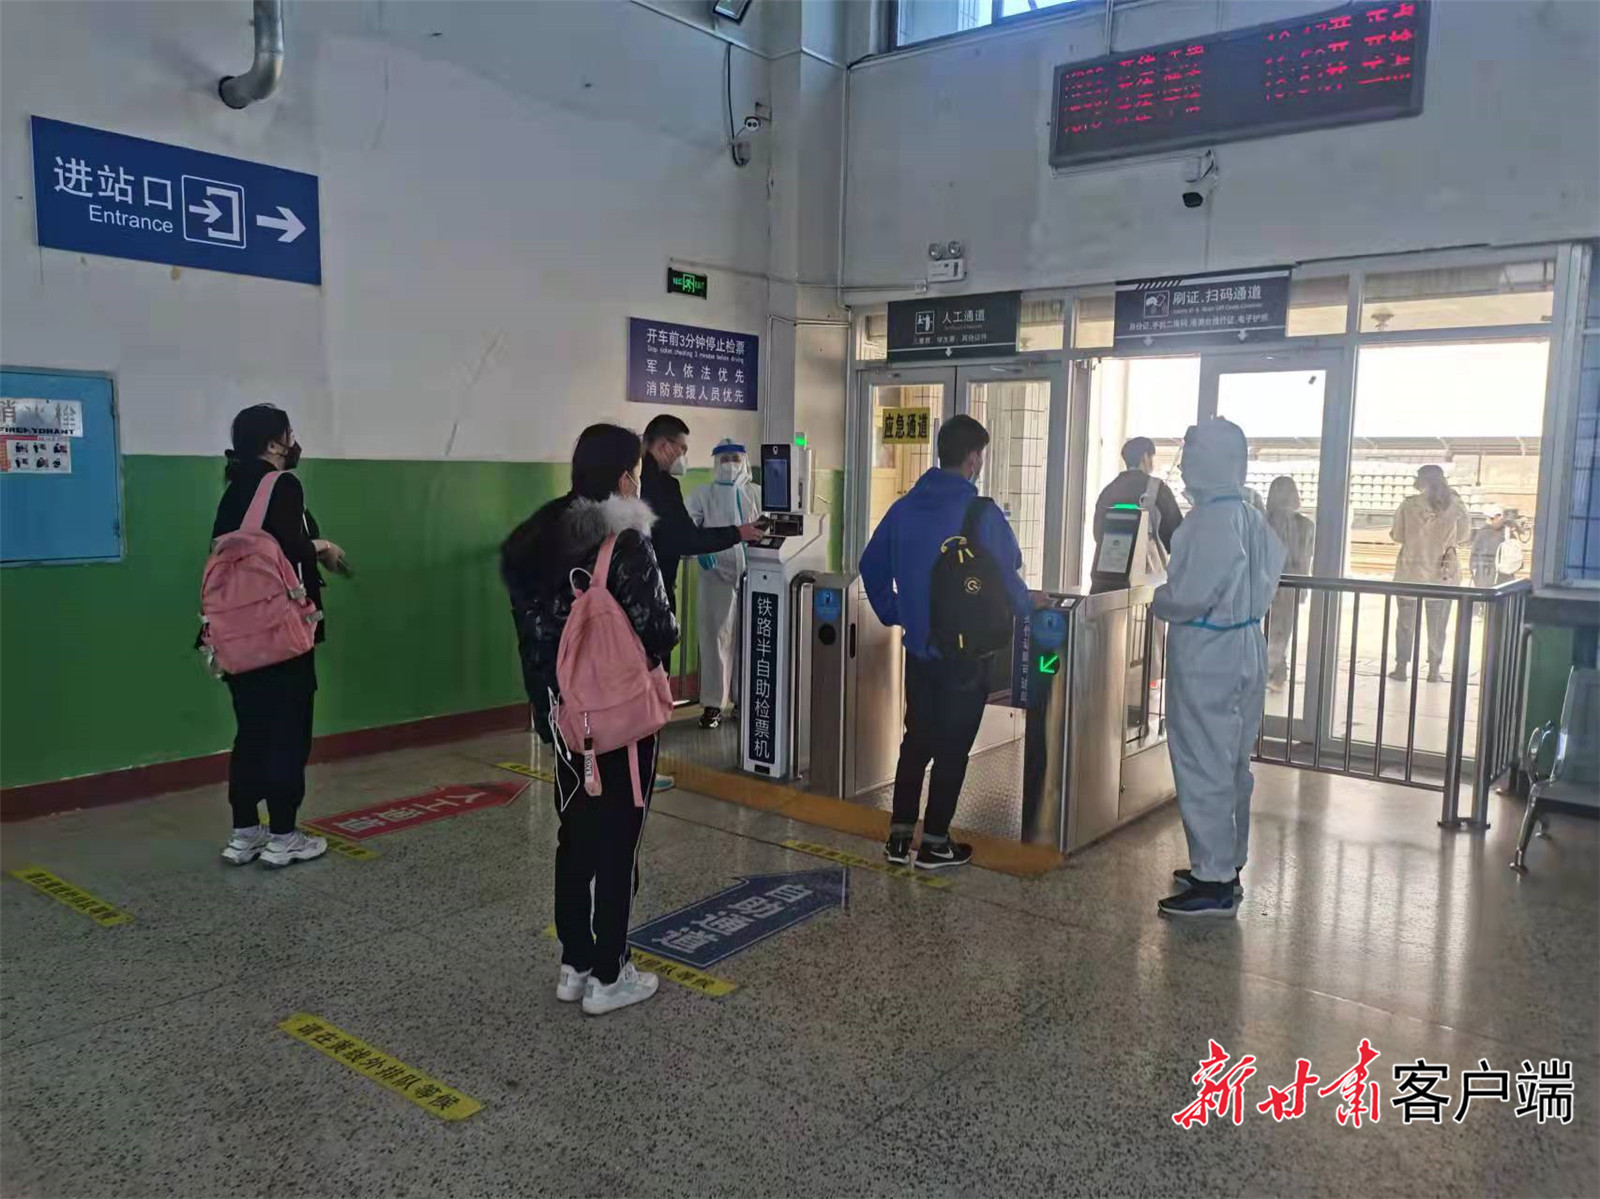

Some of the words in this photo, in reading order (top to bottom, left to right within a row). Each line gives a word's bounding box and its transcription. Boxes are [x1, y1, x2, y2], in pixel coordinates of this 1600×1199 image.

[53, 156, 173, 210] 进站口
[89, 205, 174, 234] Entrance
[942, 309, 985, 324] 人工通道
[646, 328, 745, 355] 开车前3分钟停止检票
[646, 359, 745, 383] 军人依法优先
[646, 381, 745, 403] 消防救援人员优先
[884, 411, 929, 439] 应急通道
[754, 597, 773, 758] 铁路半自助检票机
[297, 1022, 461, 1110] 请在黄线外排队等候
